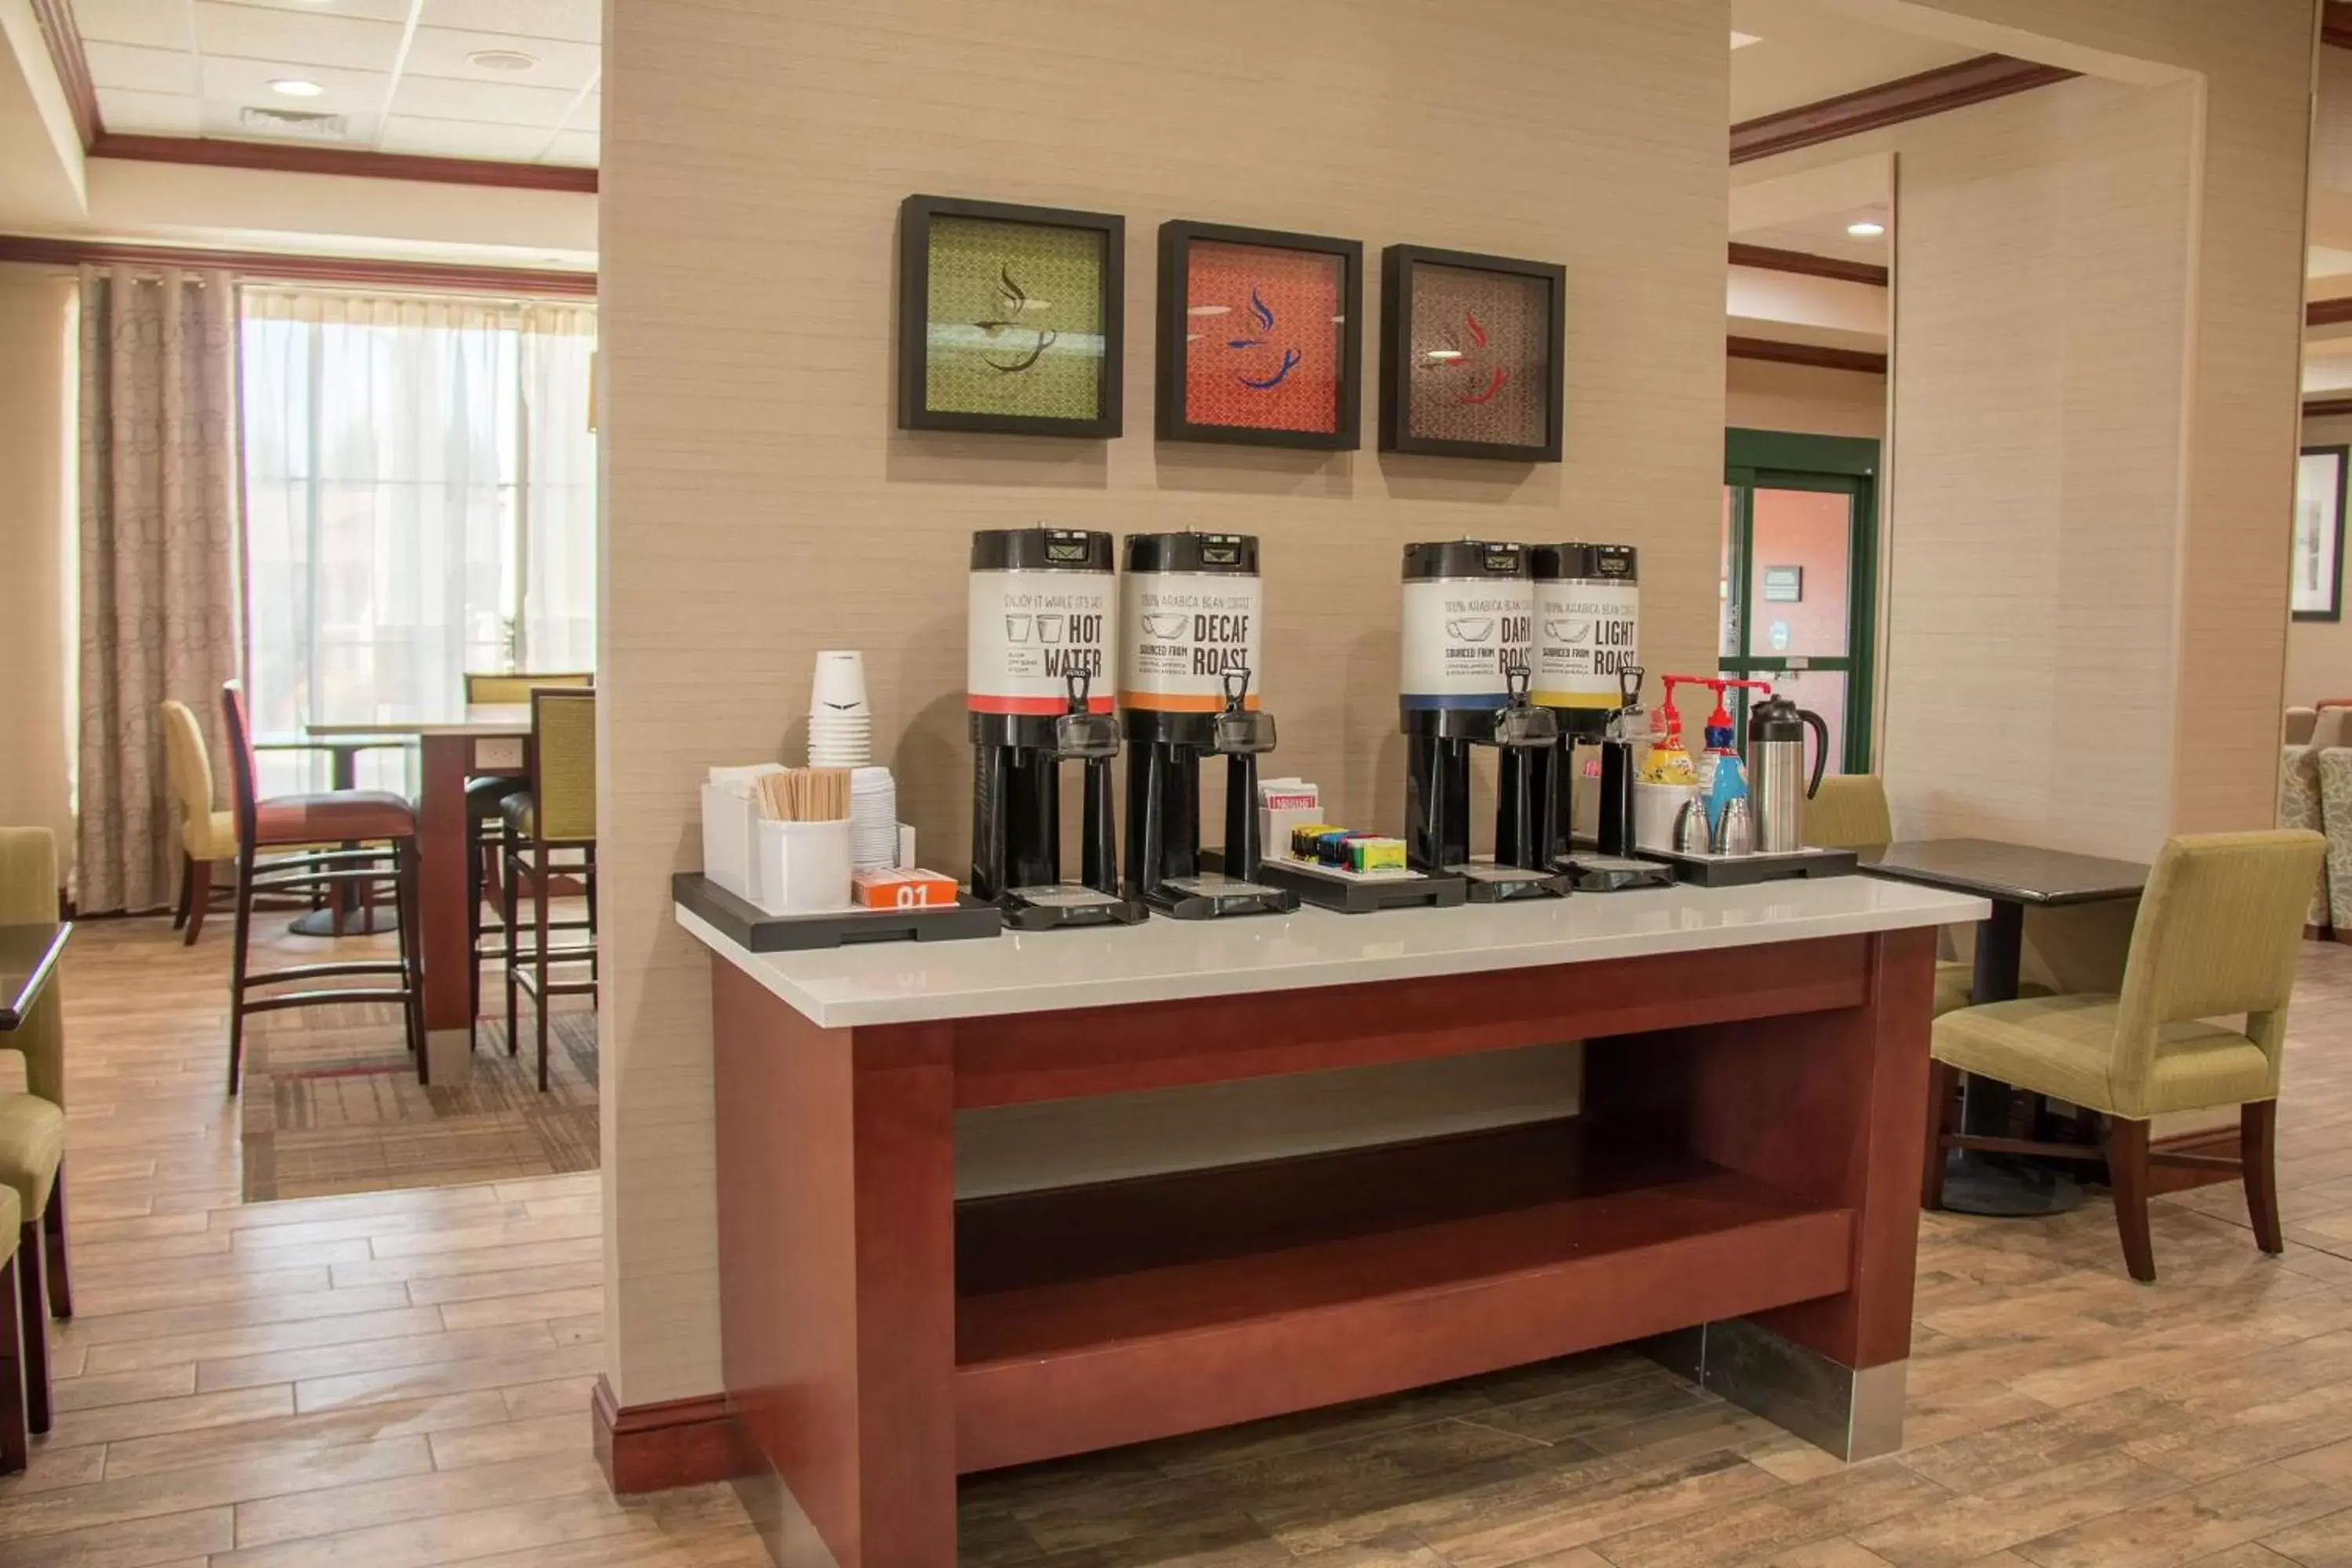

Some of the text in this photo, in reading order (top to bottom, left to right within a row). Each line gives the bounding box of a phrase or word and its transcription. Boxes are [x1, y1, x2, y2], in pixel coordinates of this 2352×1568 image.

[1069, 614, 1103, 644] HOT
[1194, 614, 1250, 643] DECAF
[1595, 619, 1635, 646] LIGHT
[1044, 648, 1102, 677] WATER
[1192, 647, 1249, 676] ROAST
[1498, 648, 1532, 675] ROAS
[1594, 650, 1635, 676] ROAST
[896, 884, 929, 908] 01
